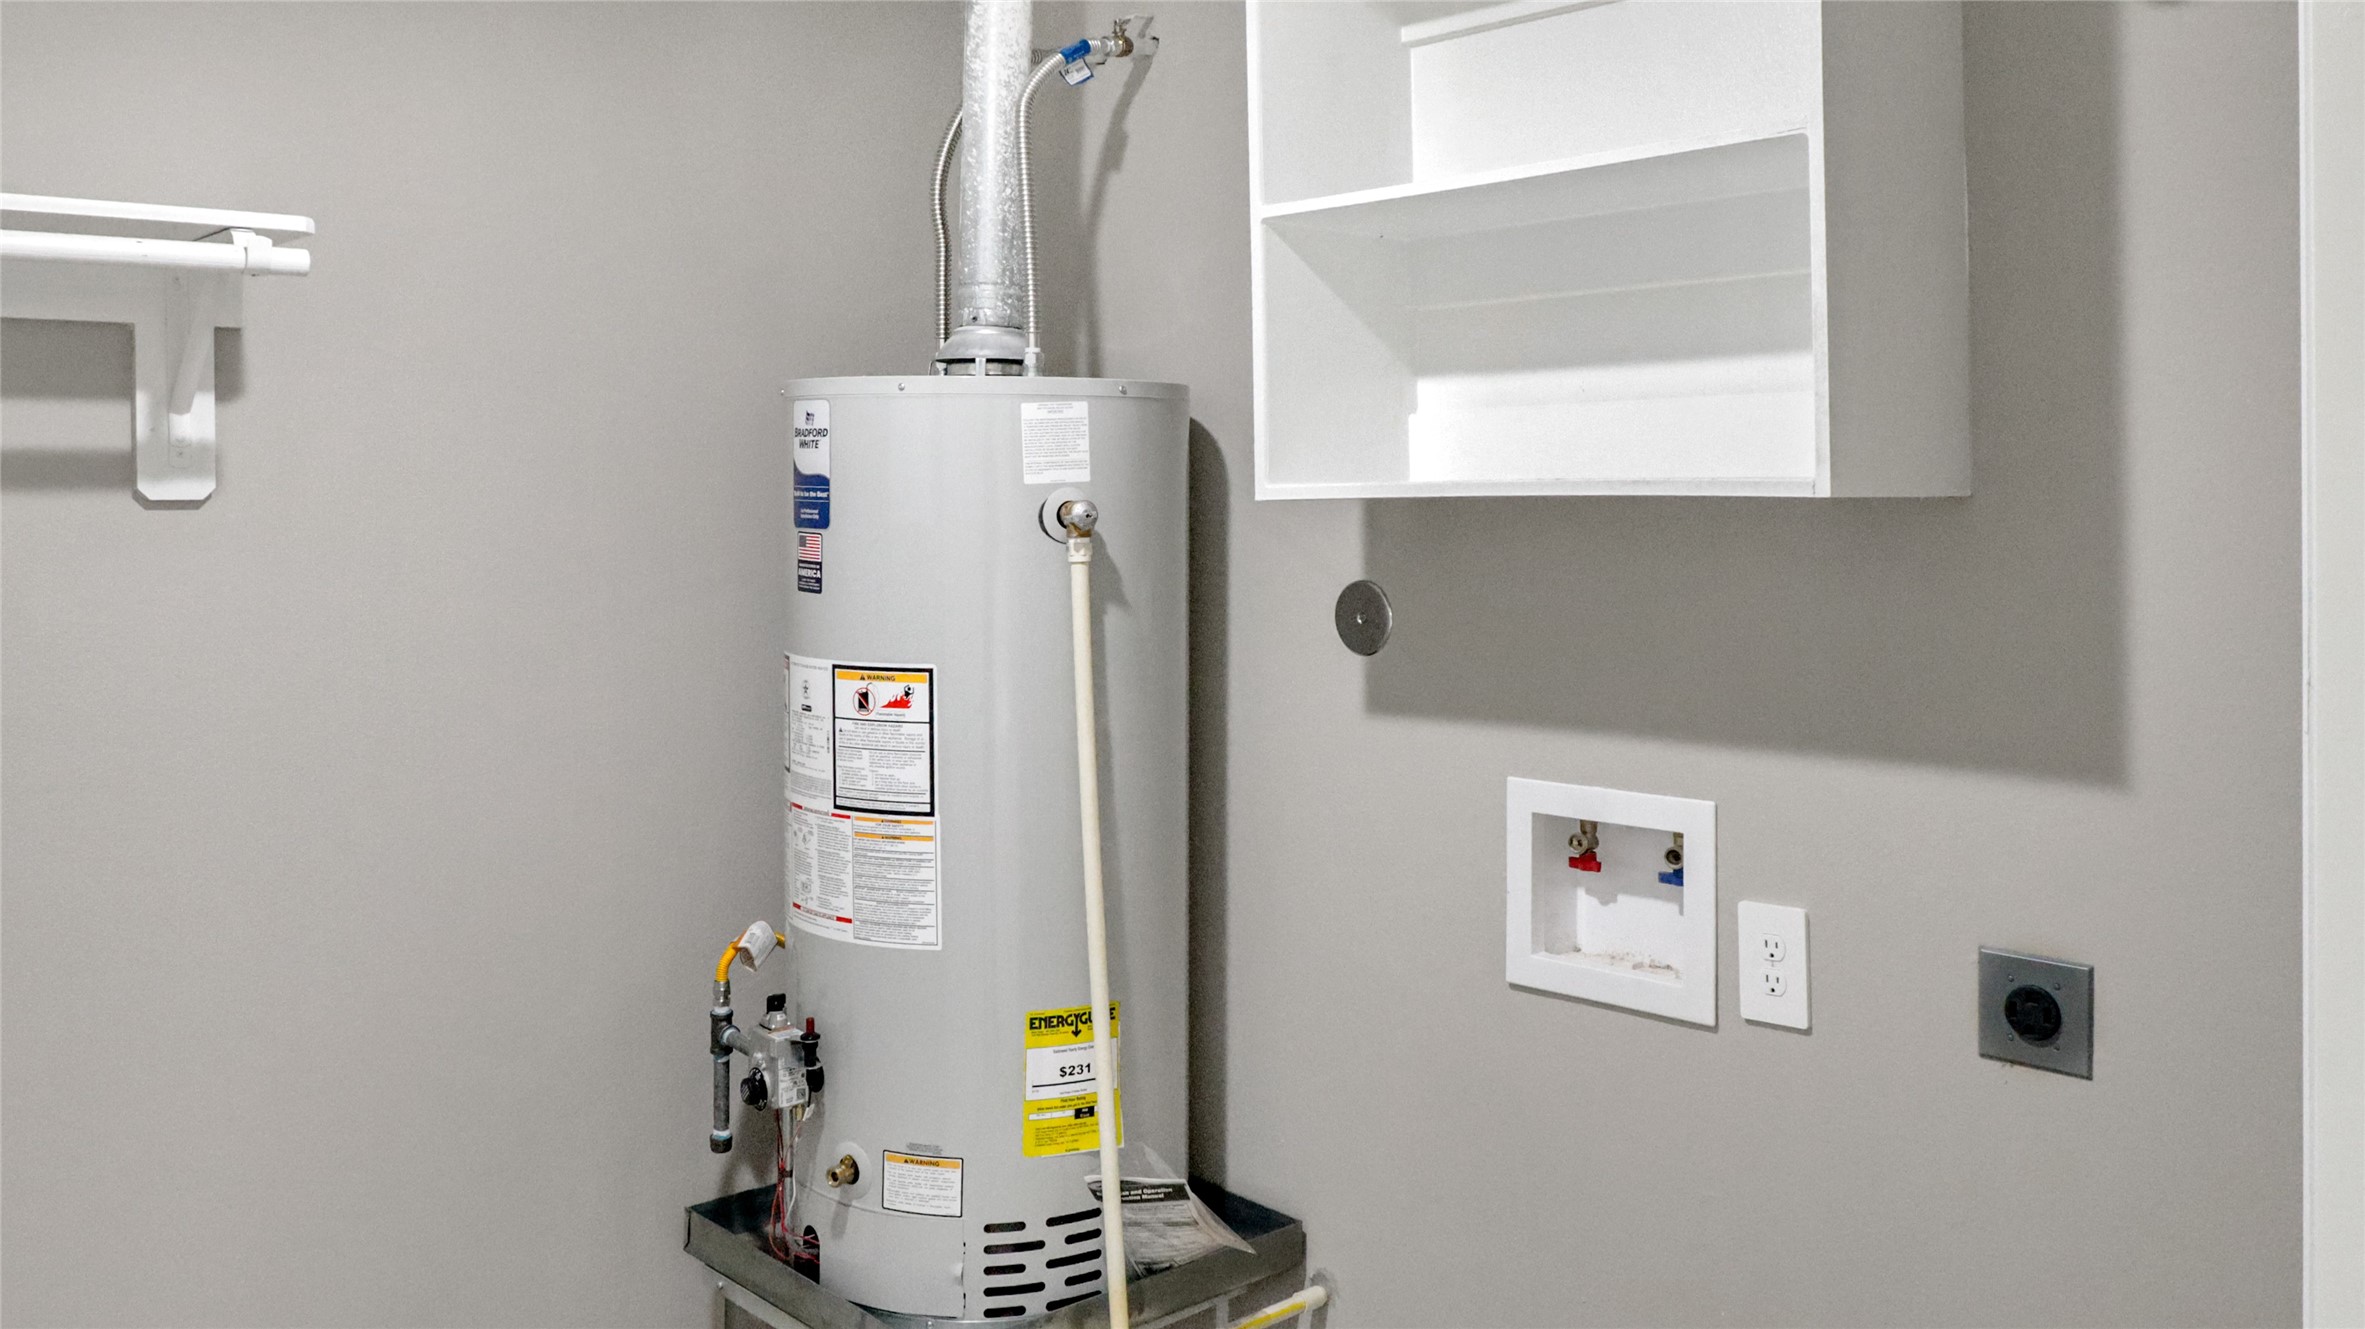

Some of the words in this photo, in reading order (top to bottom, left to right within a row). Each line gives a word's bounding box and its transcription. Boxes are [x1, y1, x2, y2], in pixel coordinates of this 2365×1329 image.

[794, 427, 829, 438] BRADFORD
[799, 439, 819, 449] WHITE
[867, 674, 896, 682] WARNING
[1059, 1063, 1092, 1078] $231
[909, 1159, 940, 1167] WARNING
